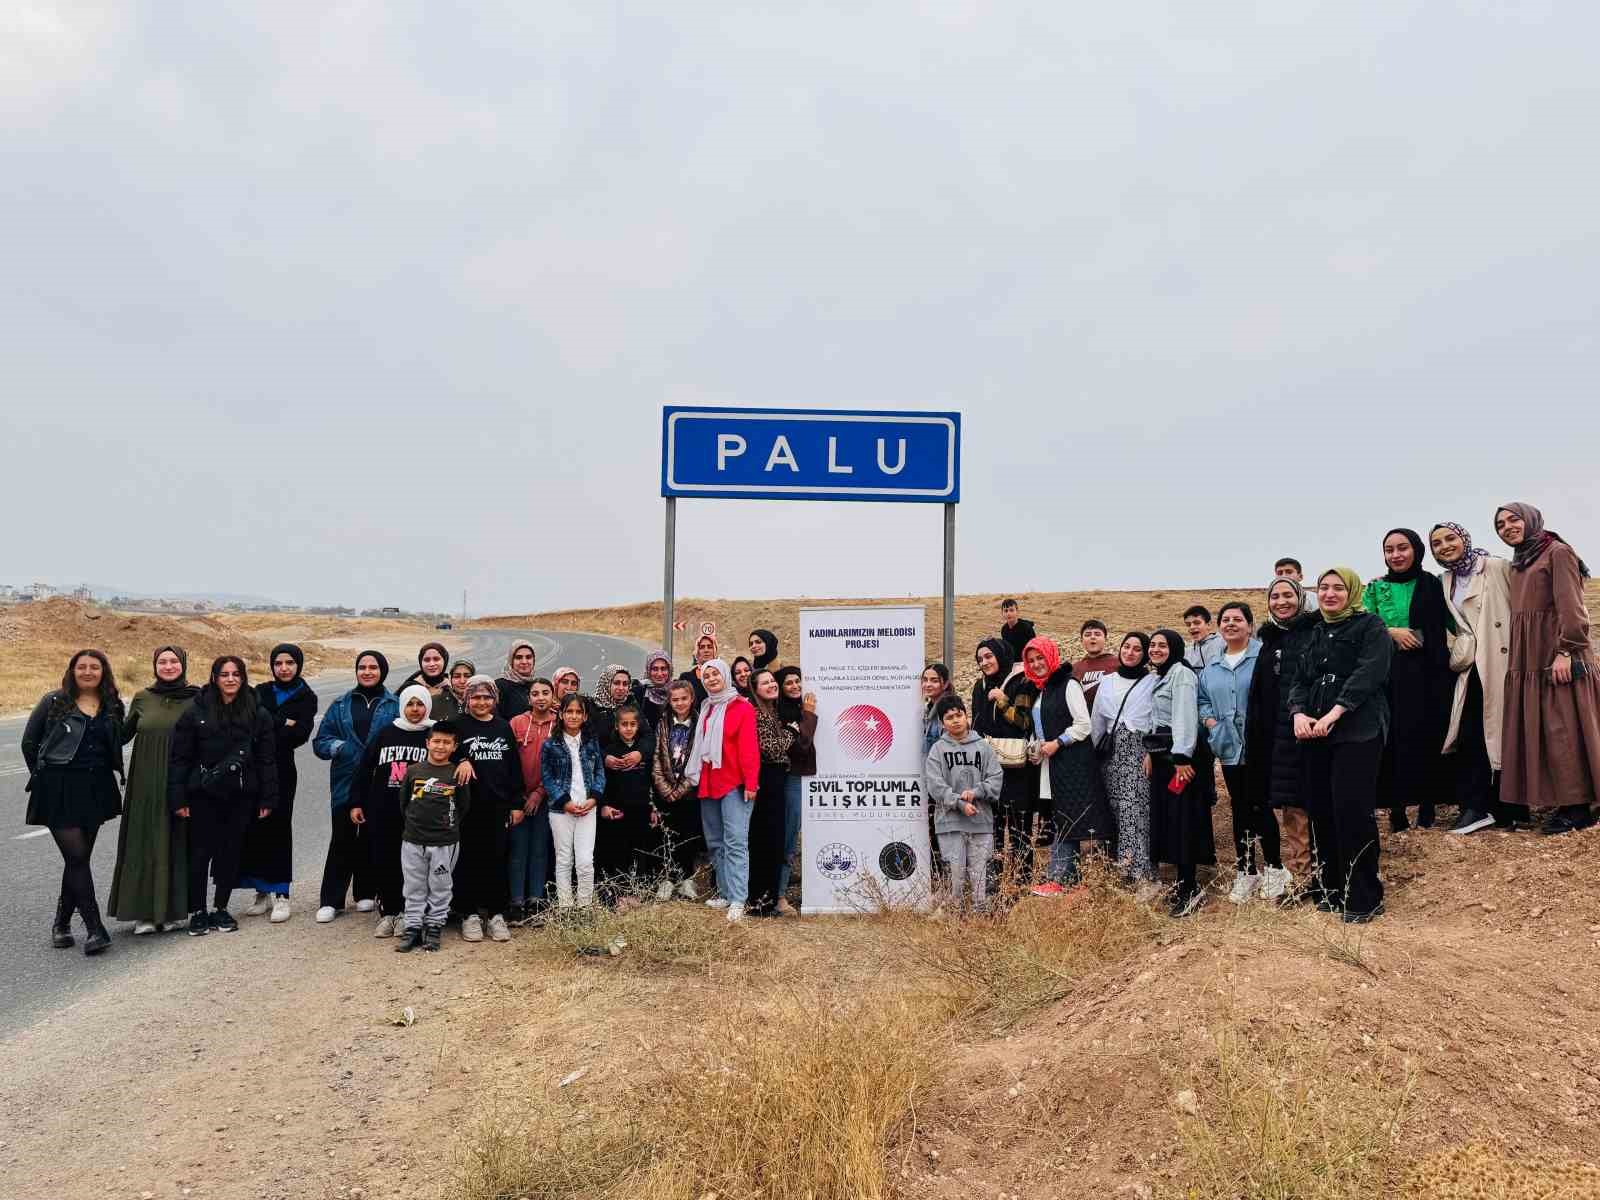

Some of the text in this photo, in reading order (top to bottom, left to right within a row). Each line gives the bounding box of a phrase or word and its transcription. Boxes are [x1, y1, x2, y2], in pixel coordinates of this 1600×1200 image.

[717, 433, 907, 475] PALU
[809, 628, 875, 638] KADINLARIMIZIN
[378, 745, 428, 766] NEWYOR
[474, 751, 503, 761] MAKER
[943, 751, 982, 772] UCLA
[846, 780, 921, 793] TOPLUMLA
